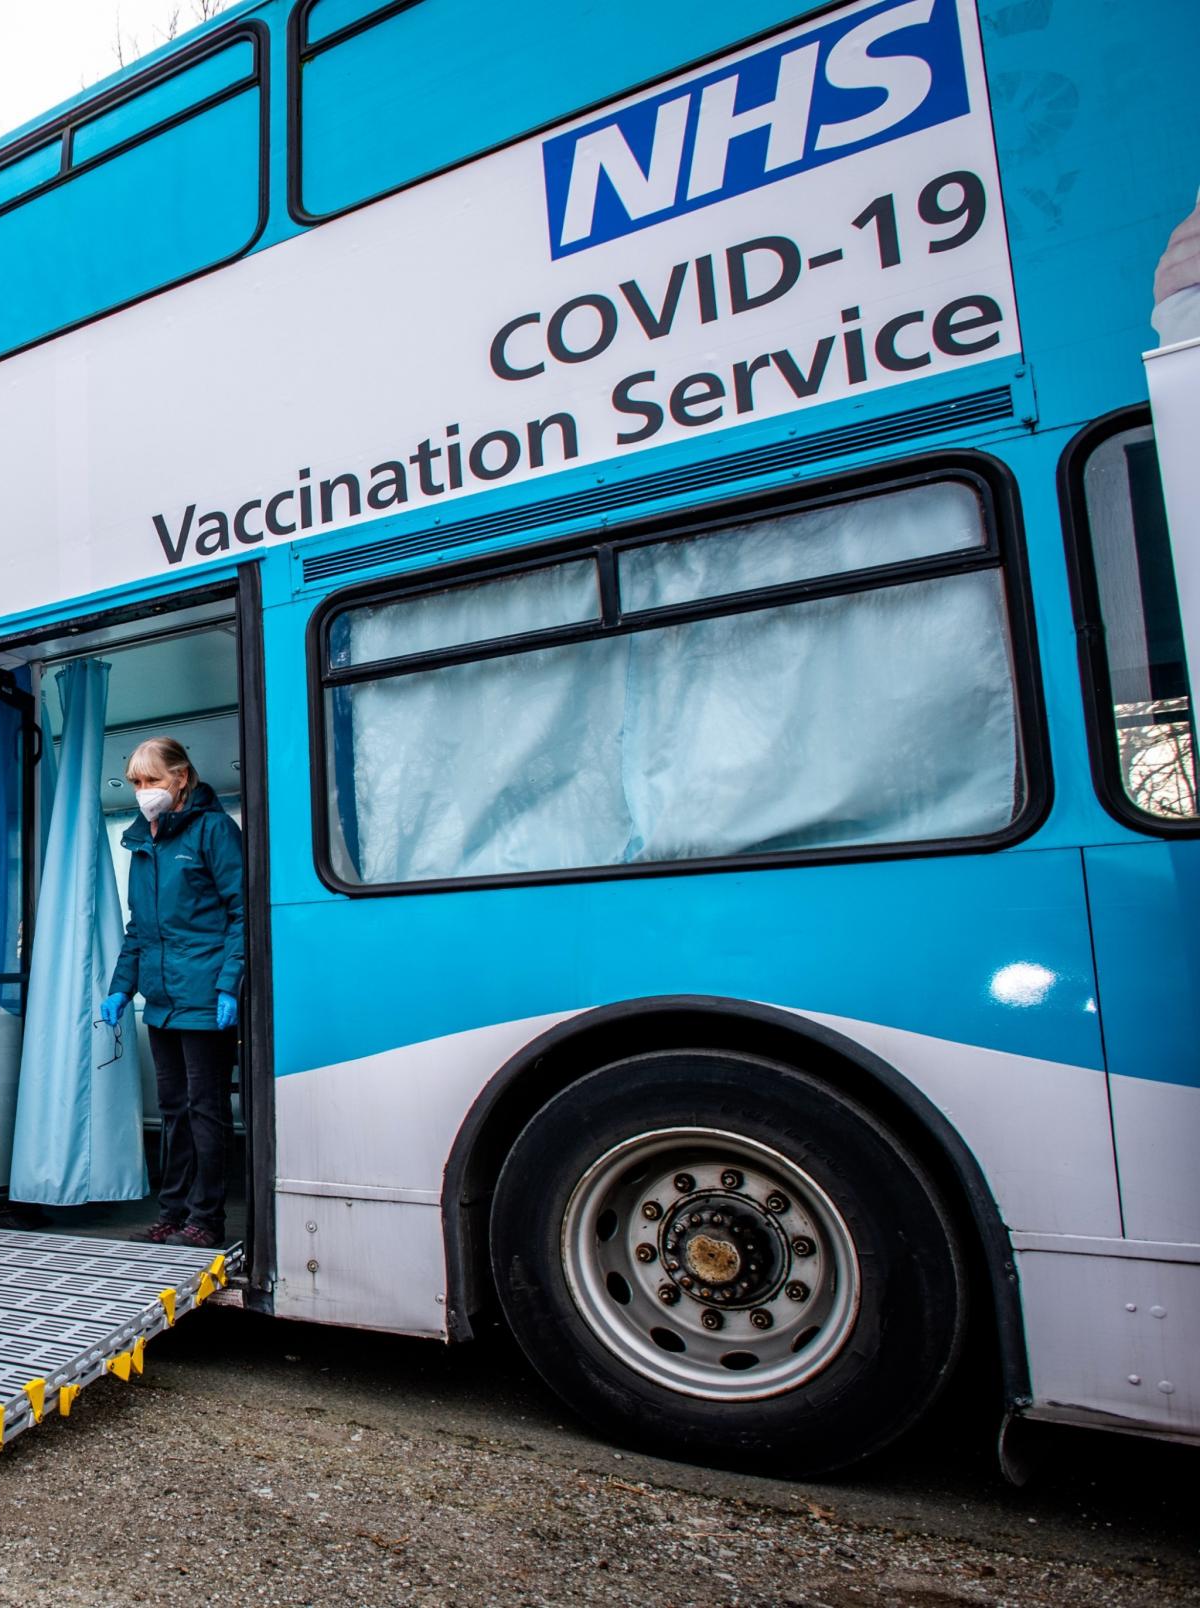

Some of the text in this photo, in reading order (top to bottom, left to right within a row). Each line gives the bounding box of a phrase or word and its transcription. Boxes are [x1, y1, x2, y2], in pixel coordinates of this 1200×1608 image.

[561, 0, 935, 247] NHS
[490, 169, 986, 381] COVID-19
[152, 294, 1003, 565] Vaccination Service
